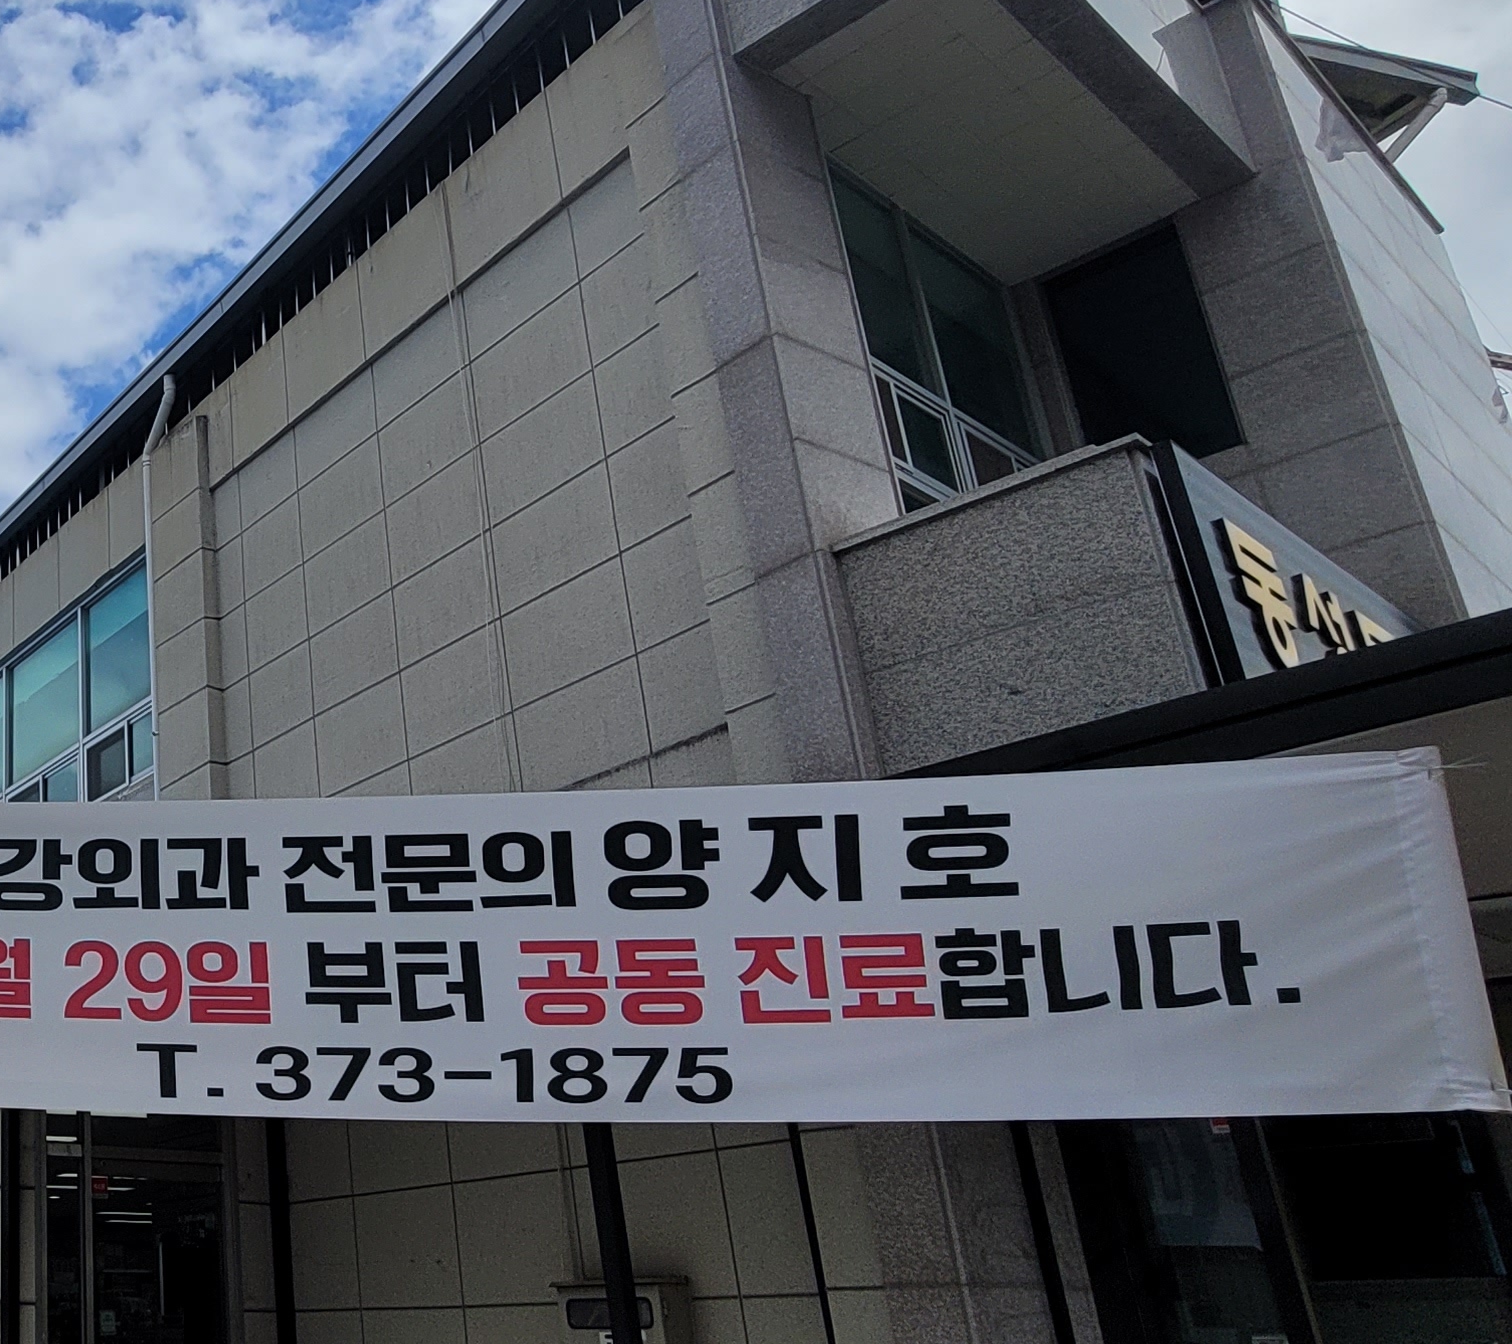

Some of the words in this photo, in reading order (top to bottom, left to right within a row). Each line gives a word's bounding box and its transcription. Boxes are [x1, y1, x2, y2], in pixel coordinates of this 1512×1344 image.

[281, 830, 578, 913] 전문의
[63, 940, 272, 1024] 29일
[304, 941, 486, 1024] 부터
[517, 938, 705, 1026] 공동
[255, 1045, 734, 1105] 373-1875
